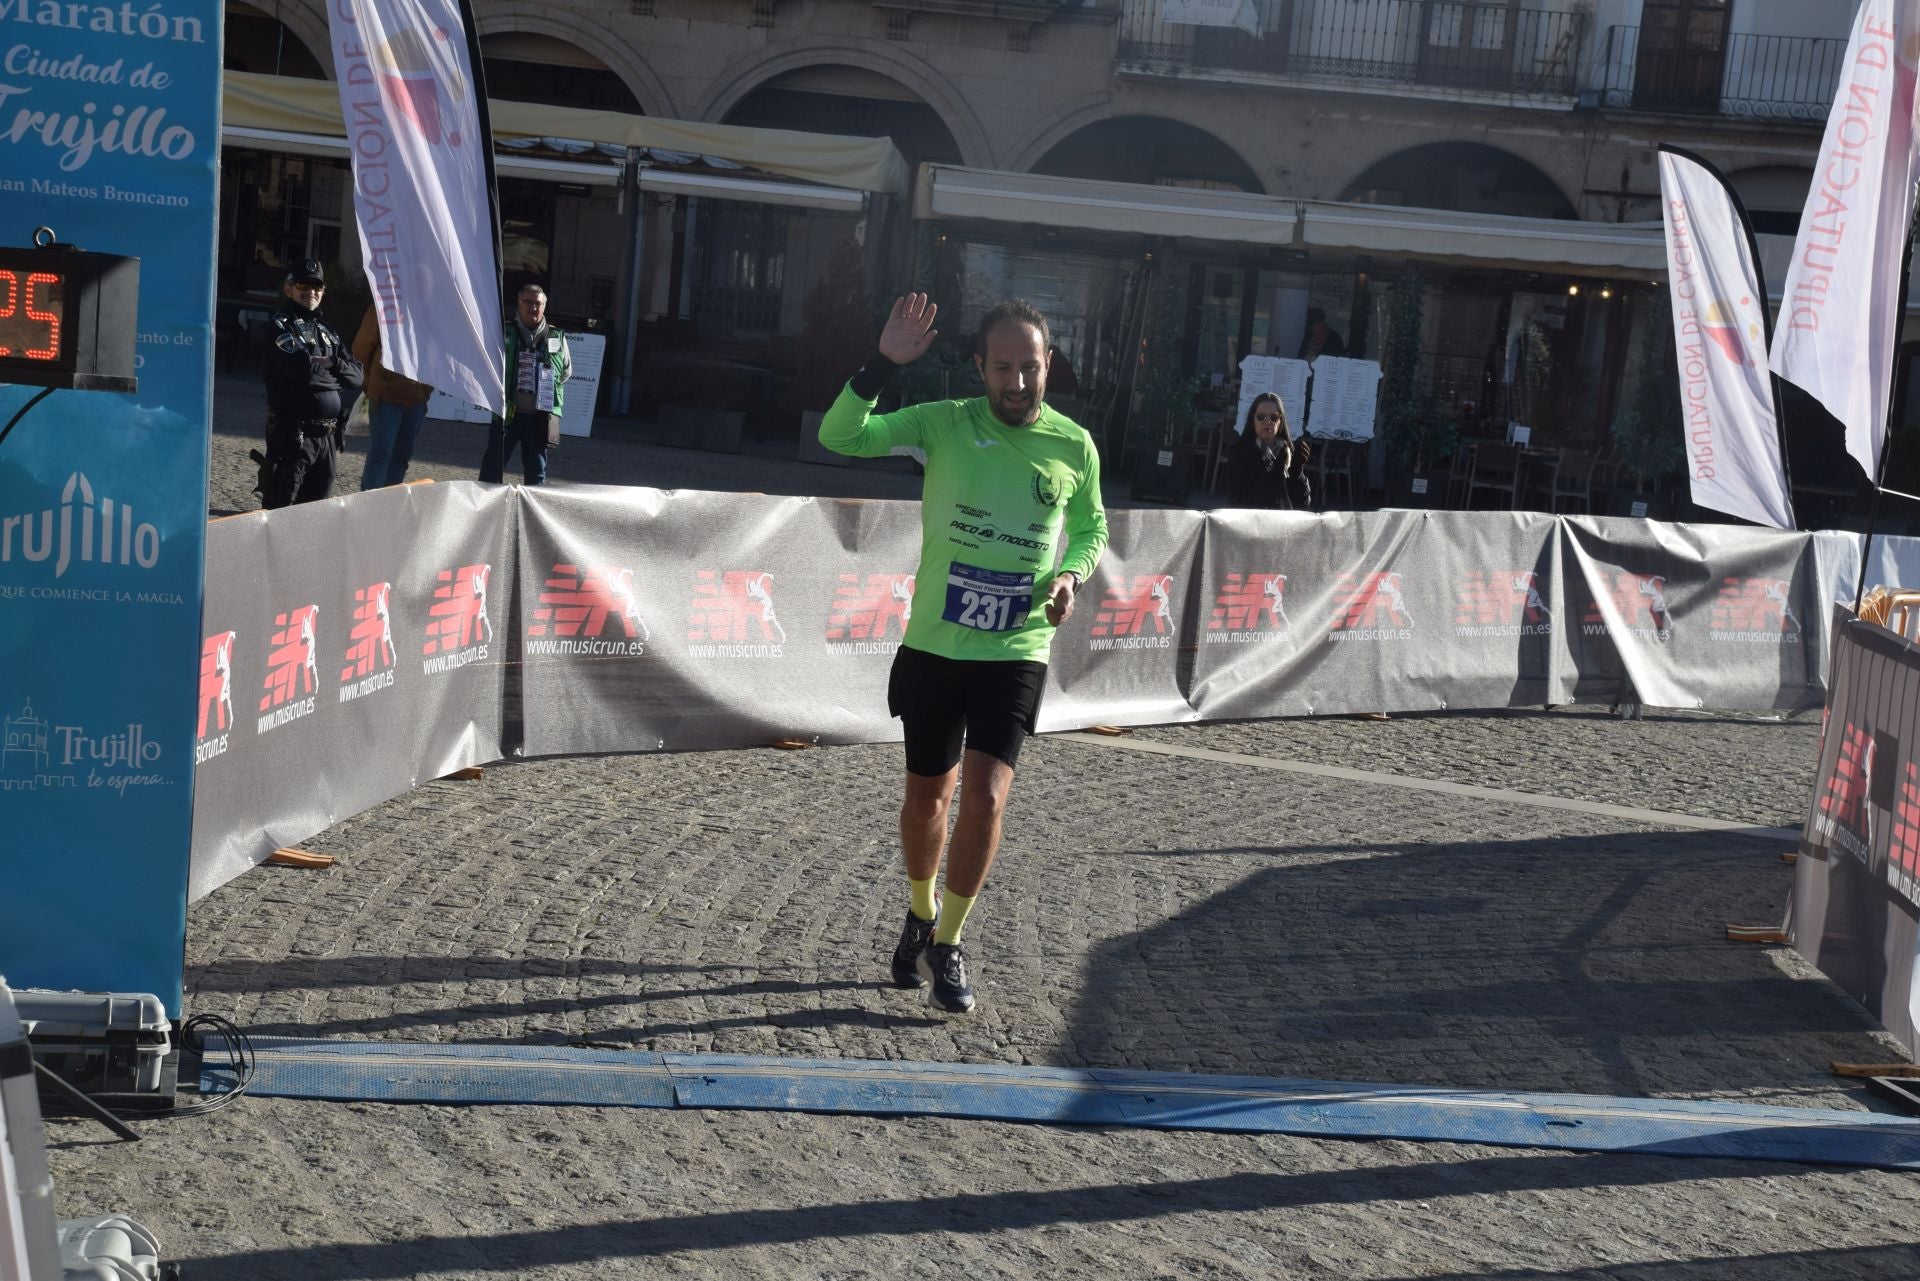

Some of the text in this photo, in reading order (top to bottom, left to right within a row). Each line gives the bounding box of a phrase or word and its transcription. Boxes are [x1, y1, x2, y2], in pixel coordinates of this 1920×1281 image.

[4, 44, 173, 89] Ciudad de
[31, 178, 98, 198] Mateos
[104, 185, 189, 207] Broncano
[135, 331, 193, 346] ento de
[2, 471, 160, 579] rujillo
[949, 520, 980, 534] PACO
[997, 533, 1050, 551] MODESTO
[31, 586, 110, 601] COMIENCE
[116, 591, 132, 601] LA
[138, 594, 183, 605] MAGIA
[958, 590, 1012, 631] 231
[1090, 633, 1170, 651] www.musicrun.es
[1206, 628, 1289, 645] www.musicrun.es
[1327, 626, 1411, 642] www.musicrun.es
[1709, 629, 1798, 644] www.musicrun.es
[526, 637, 644, 656] www.musicrun.es
[688, 641, 783, 659] www.musicrun.es
[825, 640, 902, 656] www.musicru
[423, 643, 488, 676] www.musicrun.es
[339, 669, 394, 704] www.musicrun.es
[257, 696, 315, 735] www.musicrun.es
[55, 723, 161, 768] Trujillo
[195, 733, 229, 766] sicrun.es
[88, 767, 104, 788] te
